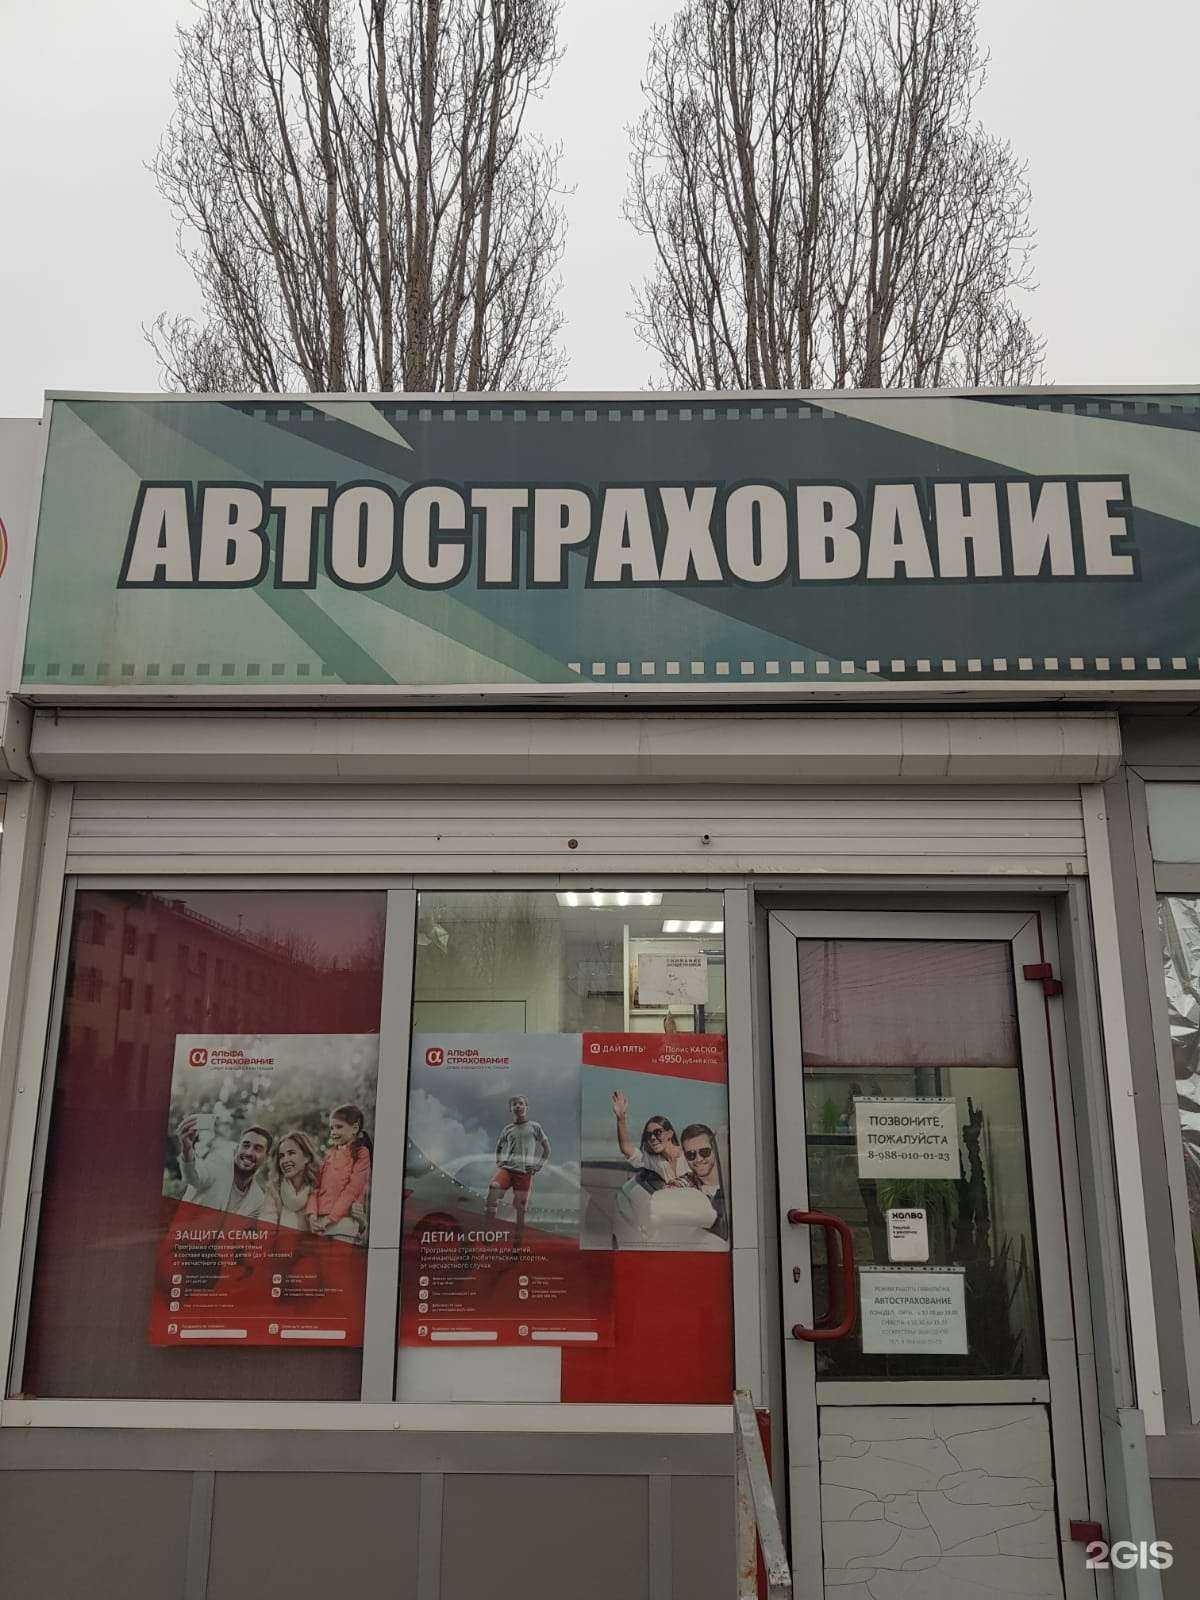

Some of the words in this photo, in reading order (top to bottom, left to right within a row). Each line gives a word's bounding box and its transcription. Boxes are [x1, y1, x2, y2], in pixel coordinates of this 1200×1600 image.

[121, 477, 1137, 587] АВТОСТРАХОВАНИЕ
[602, 1044, 621, 1053] ДАЙ
[690, 1046, 717, 1054] КАСКО
[658, 1055, 682, 1064] 4950
[870, 1116, 944, 1128] ПОЗВОНИТЕ,
[868, 1132, 949, 1144] ПОЖАЛУЙСТА
[175, 1230, 224, 1241] ЗАЩИТА
[228, 1230, 268, 1240] СЕМЬИ
[421, 1232, 454, 1243] ДЕТИ
[468, 1231, 510, 1242] СПОРТ
[874, 1296, 952, 1304] АВТОСТРАХОВАНИЕ
